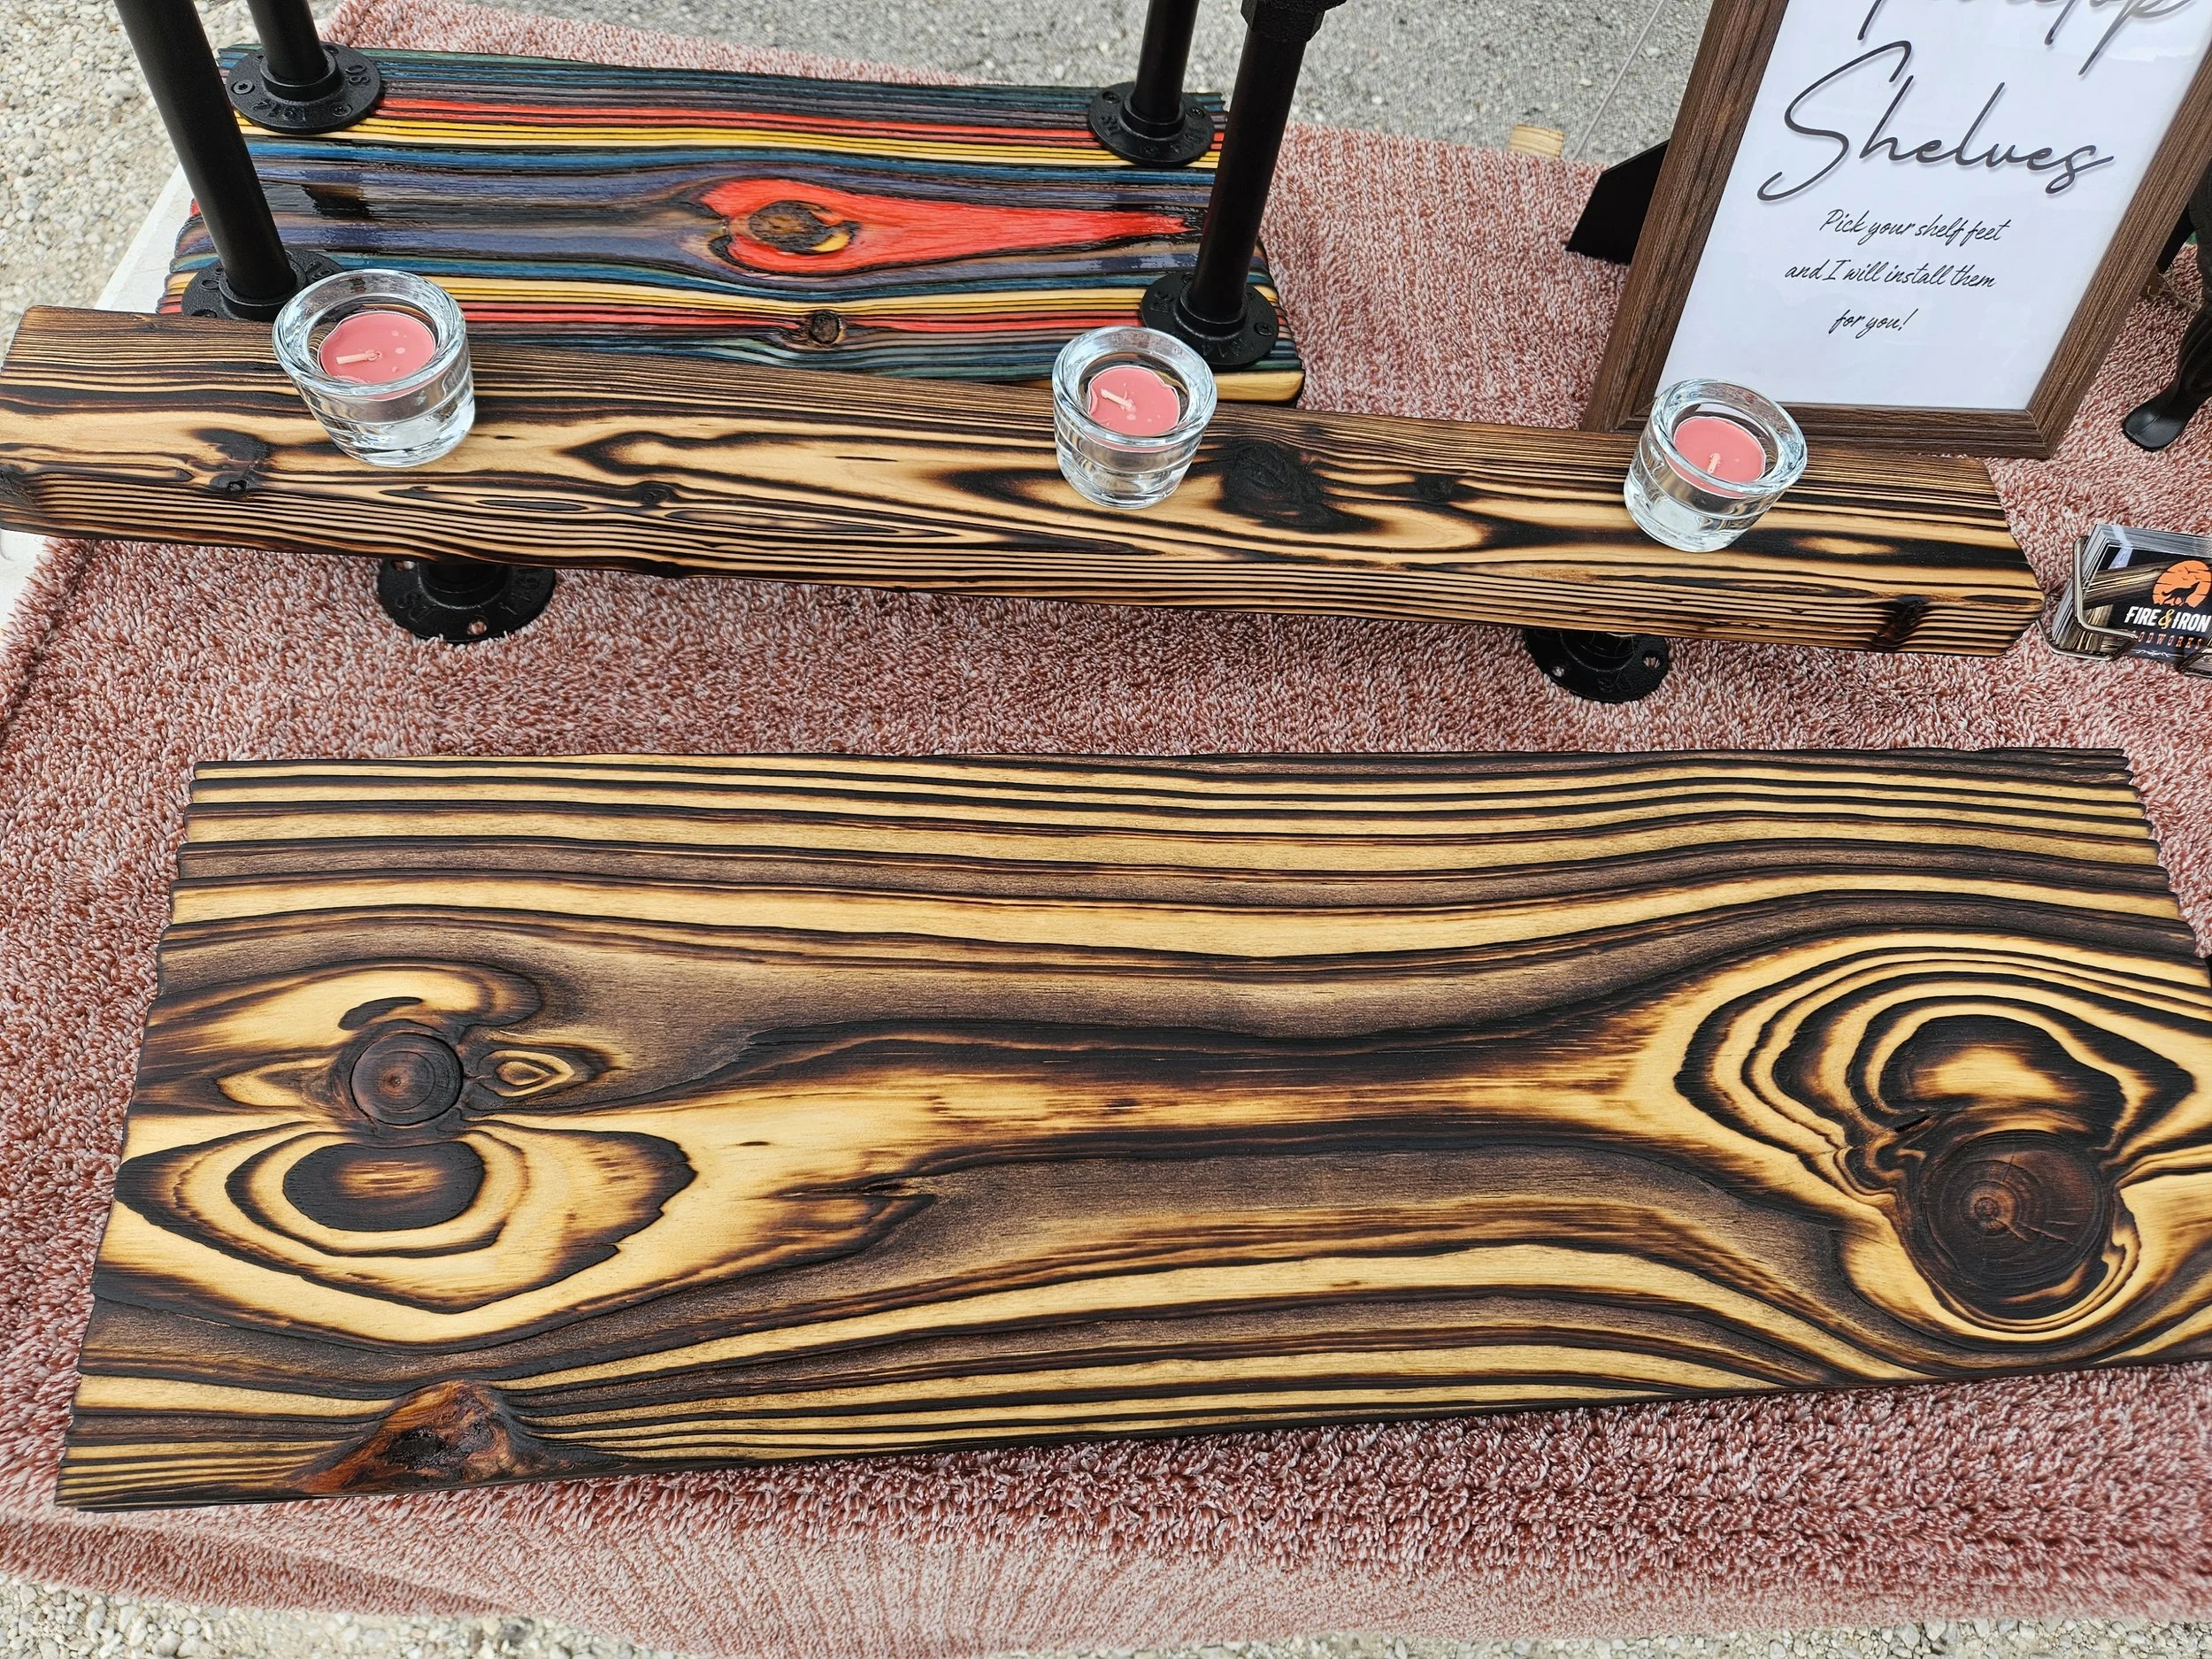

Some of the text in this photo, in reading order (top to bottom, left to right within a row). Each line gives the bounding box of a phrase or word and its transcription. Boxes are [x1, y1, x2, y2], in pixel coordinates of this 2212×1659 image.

[1757, 40, 2115, 202] Shelves
[1818, 209, 2012, 247] Pick your shelf feet
[1785, 259, 1997, 288] and I will install them
[1828, 308, 1919, 339] for you!
[2124, 605, 2212, 633] FIRE & IRON
[2138, 631, 2203, 649] ODWORKS
